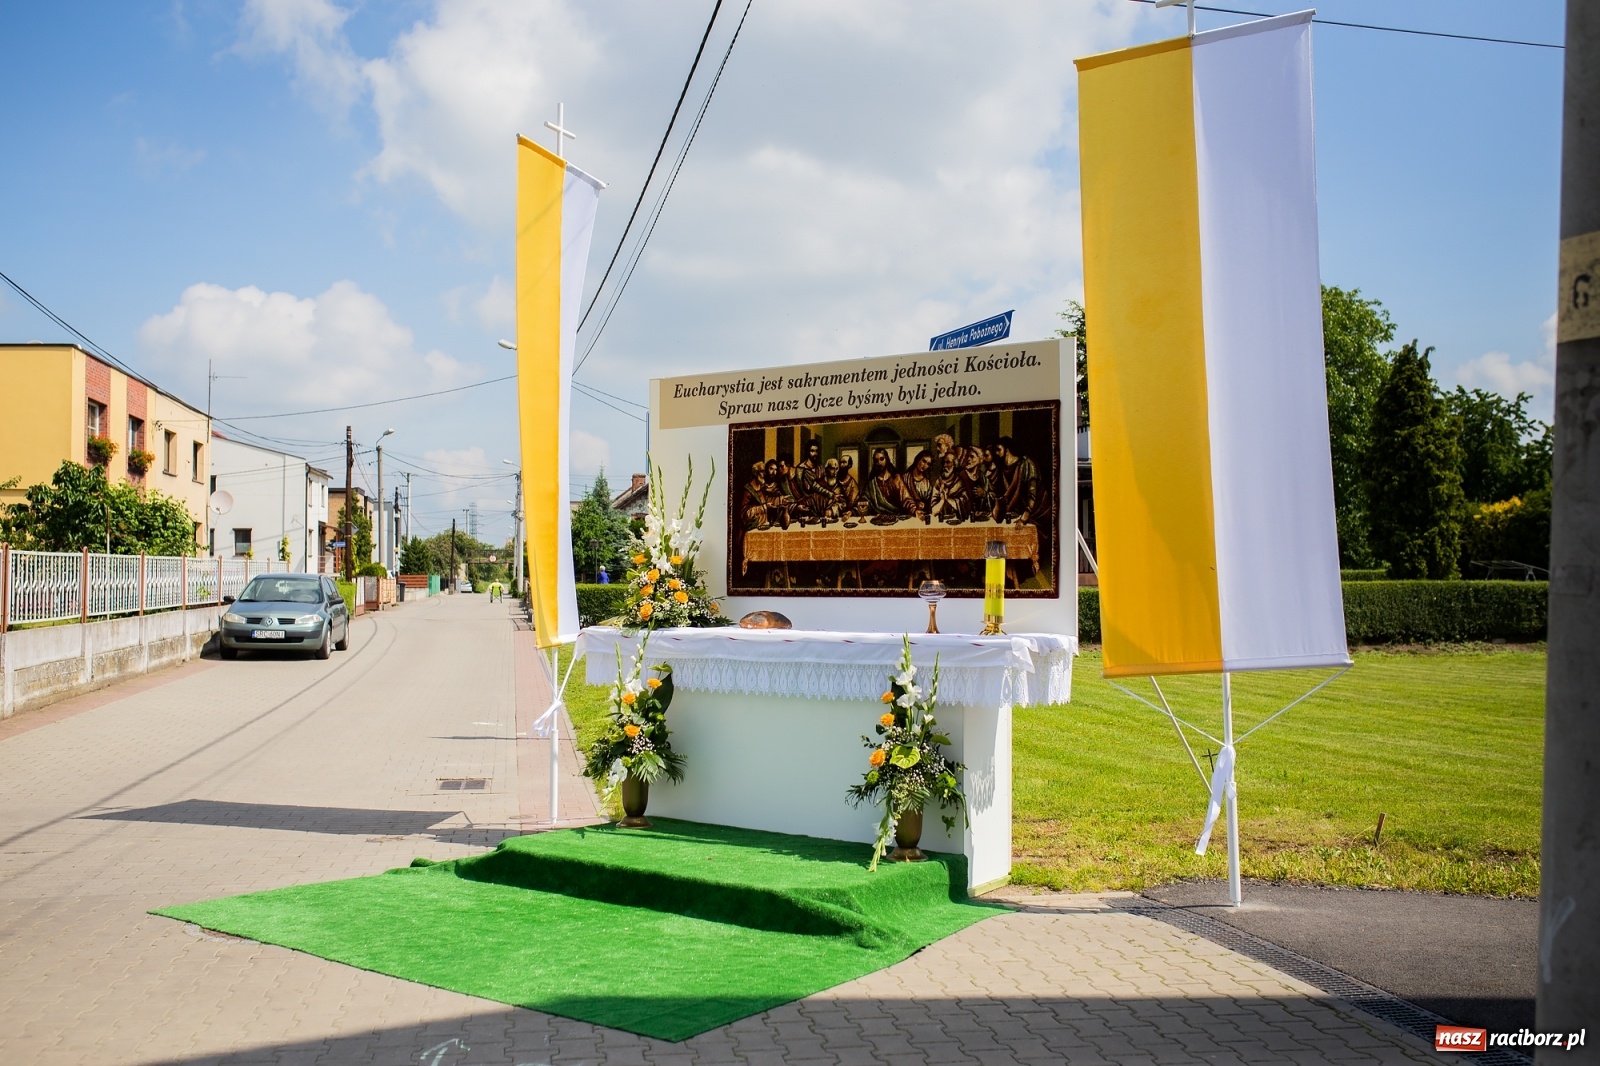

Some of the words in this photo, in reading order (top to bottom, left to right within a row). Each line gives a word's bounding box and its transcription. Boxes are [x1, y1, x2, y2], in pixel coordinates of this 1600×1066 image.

[946, 332, 968, 349] Henryka
[673, 377, 755, 399] Eucharystia
[757, 375, 784, 395] jest
[787, 368, 888, 389] sakramentem
[891, 357, 959, 383] jedności
[964, 351, 1041, 373] Kościoła.
[718, 400, 763, 419] Spraw
[767, 399, 799, 412] nasz
[804, 393, 843, 412] Ojcze
[847, 389, 893, 408] byśmy
[898, 384, 927, 404] byli
[929, 381, 981, 402] jedno.
